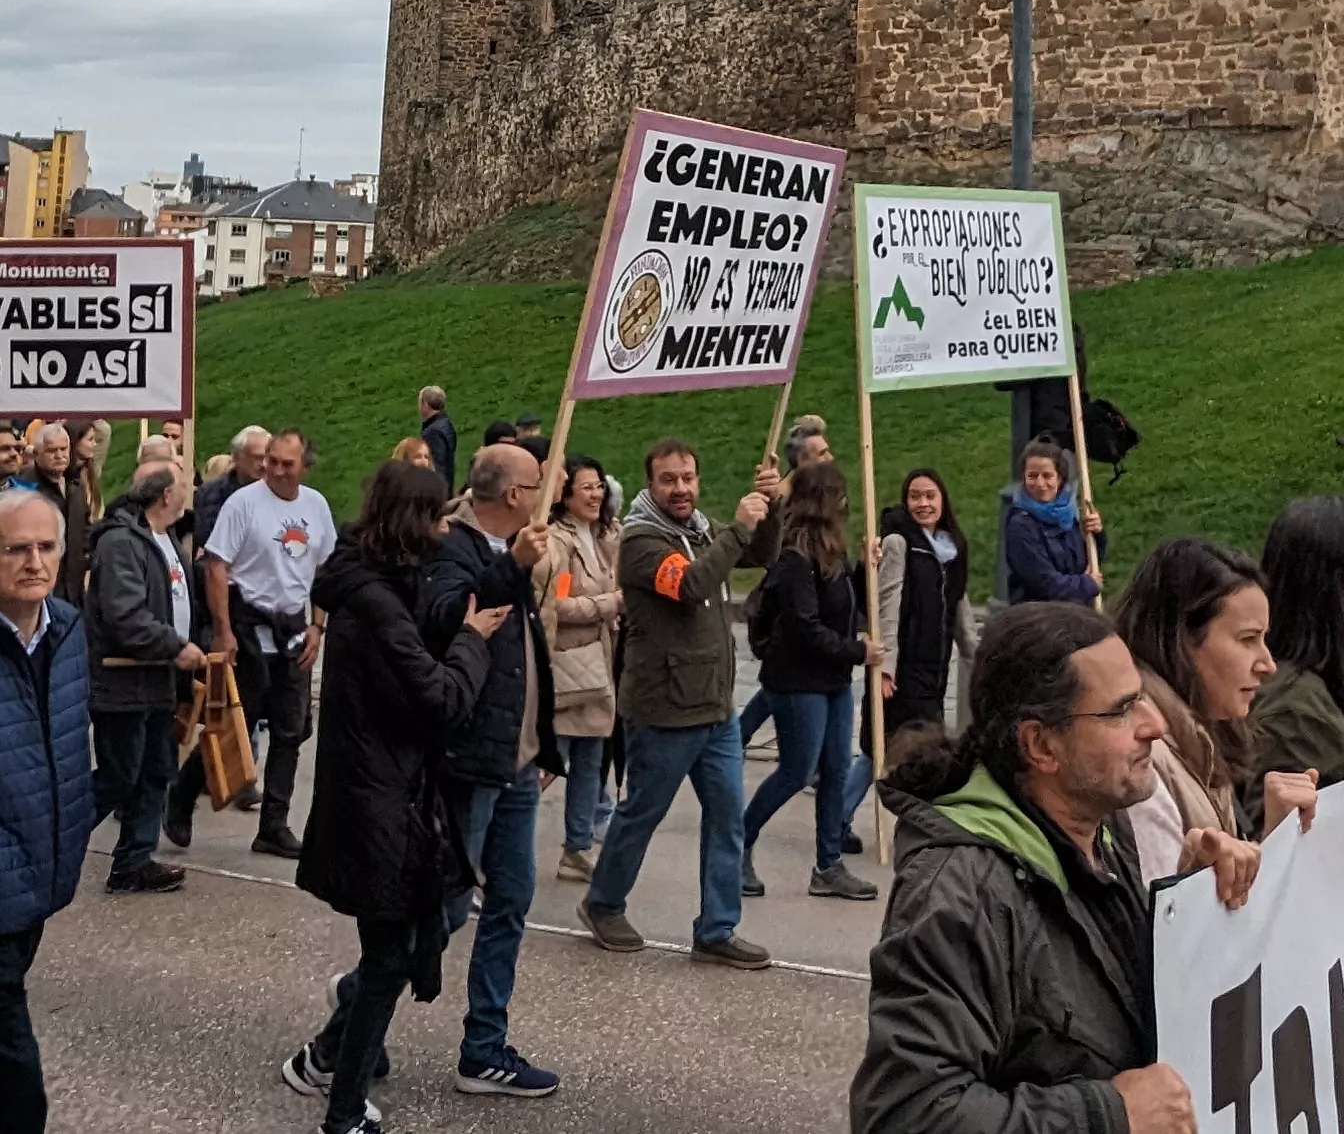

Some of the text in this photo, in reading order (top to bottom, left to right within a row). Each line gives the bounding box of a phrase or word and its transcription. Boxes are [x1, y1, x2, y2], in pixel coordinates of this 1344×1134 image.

[644, 139, 830, 204] ¿GENERAN
[647, 200, 808, 252] EMPLEO?
[873, 208, 1023, 259] ¿EXPROPIACIONES
[675, 255, 804, 318] NO ES VERDAD
[930, 257, 968, 306] BIEN
[131, 286, 169, 331] SÍ
[1016, 308, 1057, 329] BIEN
[12, 349, 68, 386] NO
[76, 340, 141, 386] ASÍ
[655, 325, 791, 371] MIENTEN
[993, 332, 1059, 360] QUIEN?
